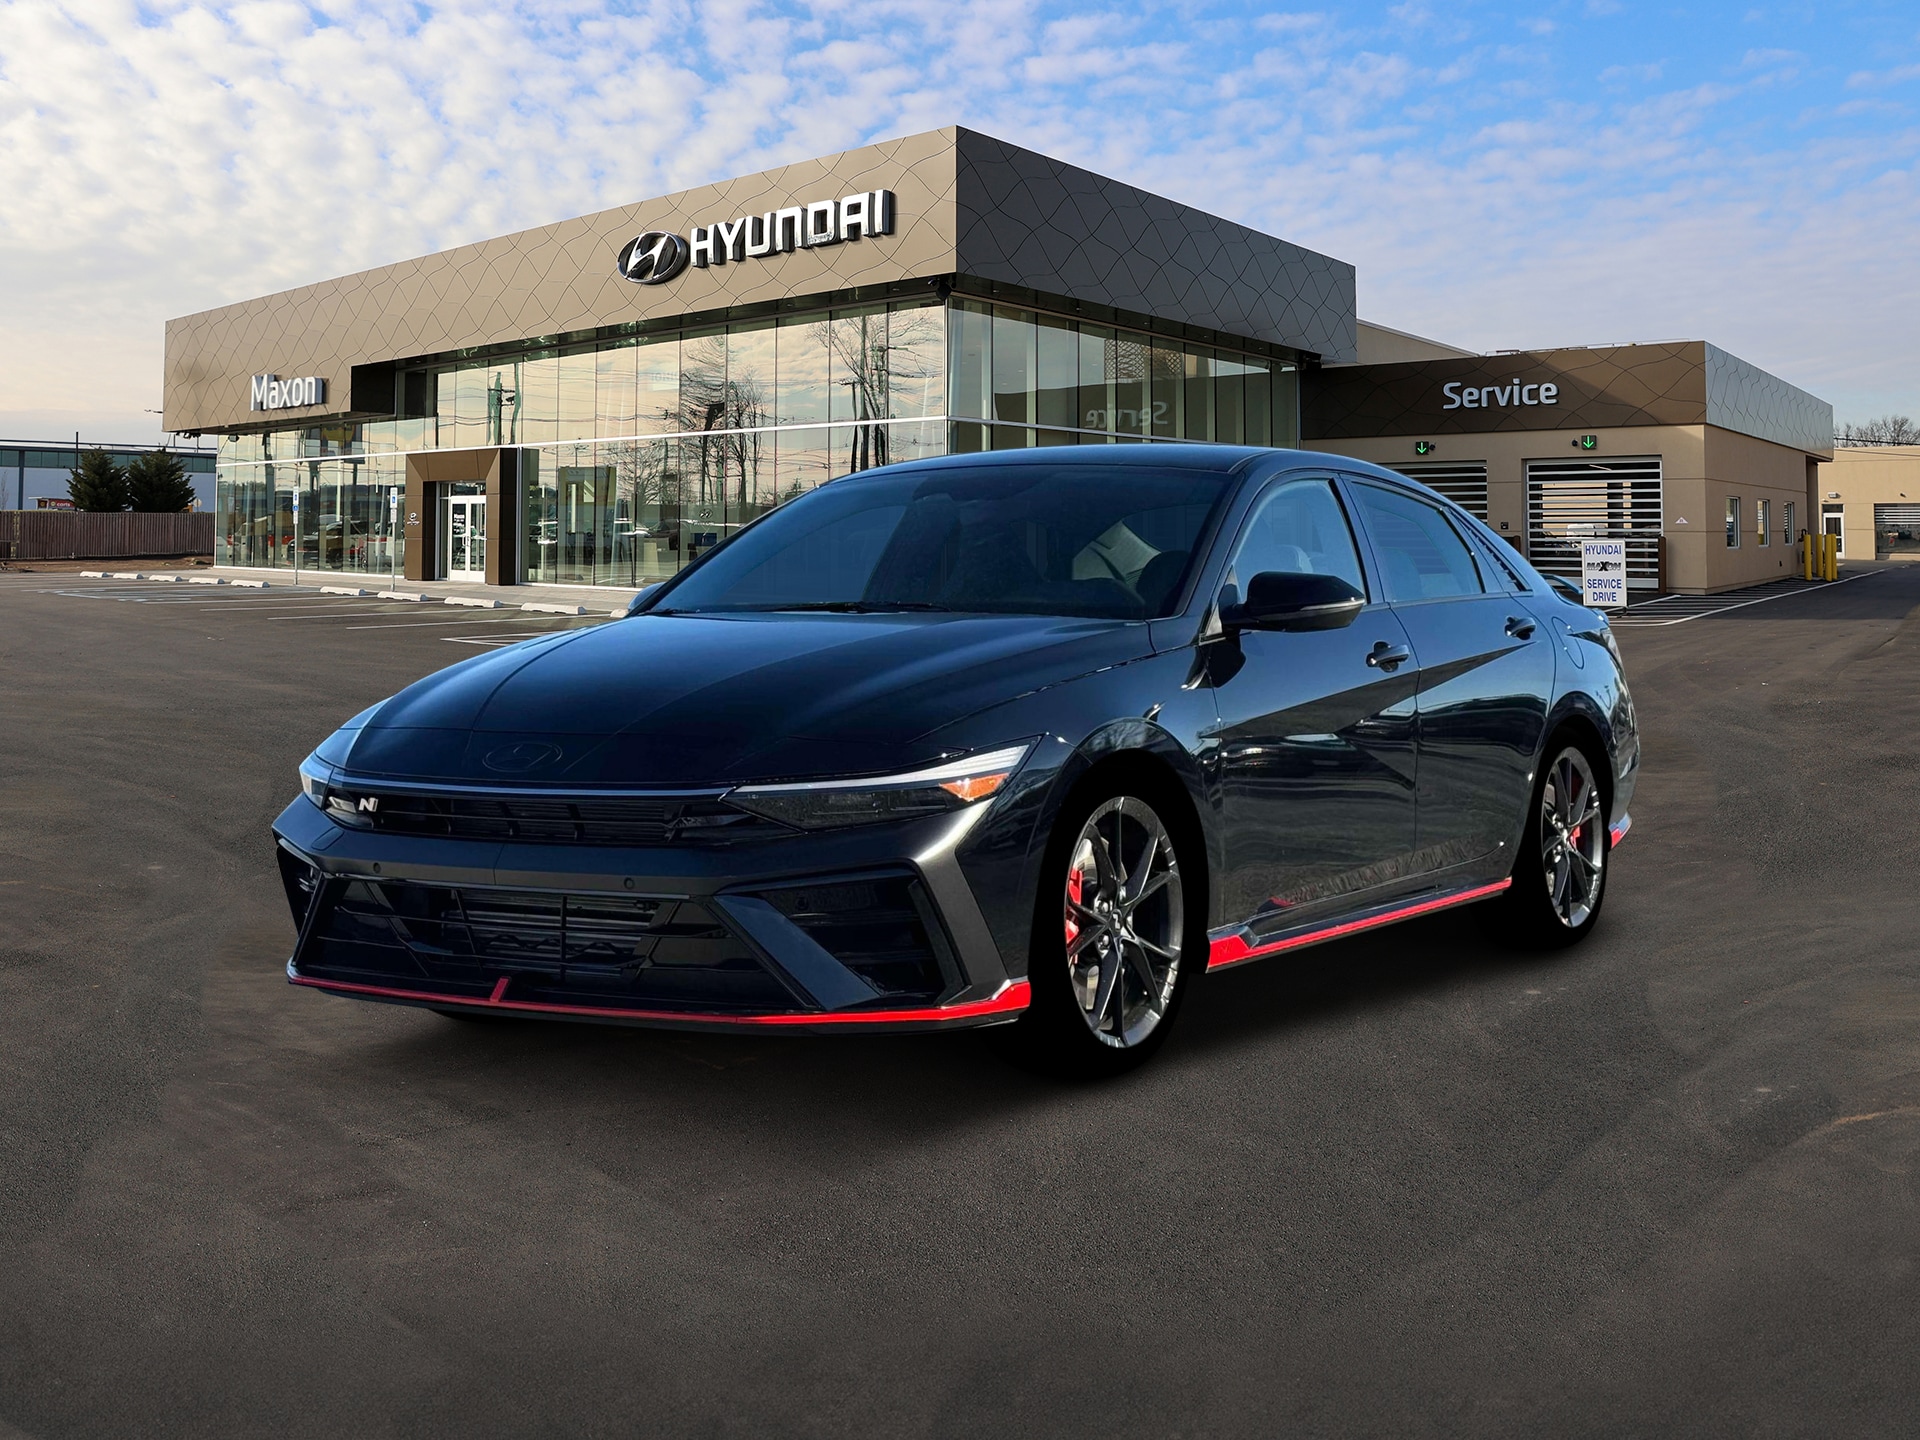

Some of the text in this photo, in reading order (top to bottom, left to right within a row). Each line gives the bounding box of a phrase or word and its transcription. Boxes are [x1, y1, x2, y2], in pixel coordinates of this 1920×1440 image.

[690, 189, 892, 267] HYUNDAI
[250, 373, 321, 411] Maxon
[1443, 378, 1559, 409] Service
[1585, 544, 1622, 555] HYUNDAI
[1587, 578, 1622, 589] SERVICE
[1592, 591, 1617, 602] DRIVE
